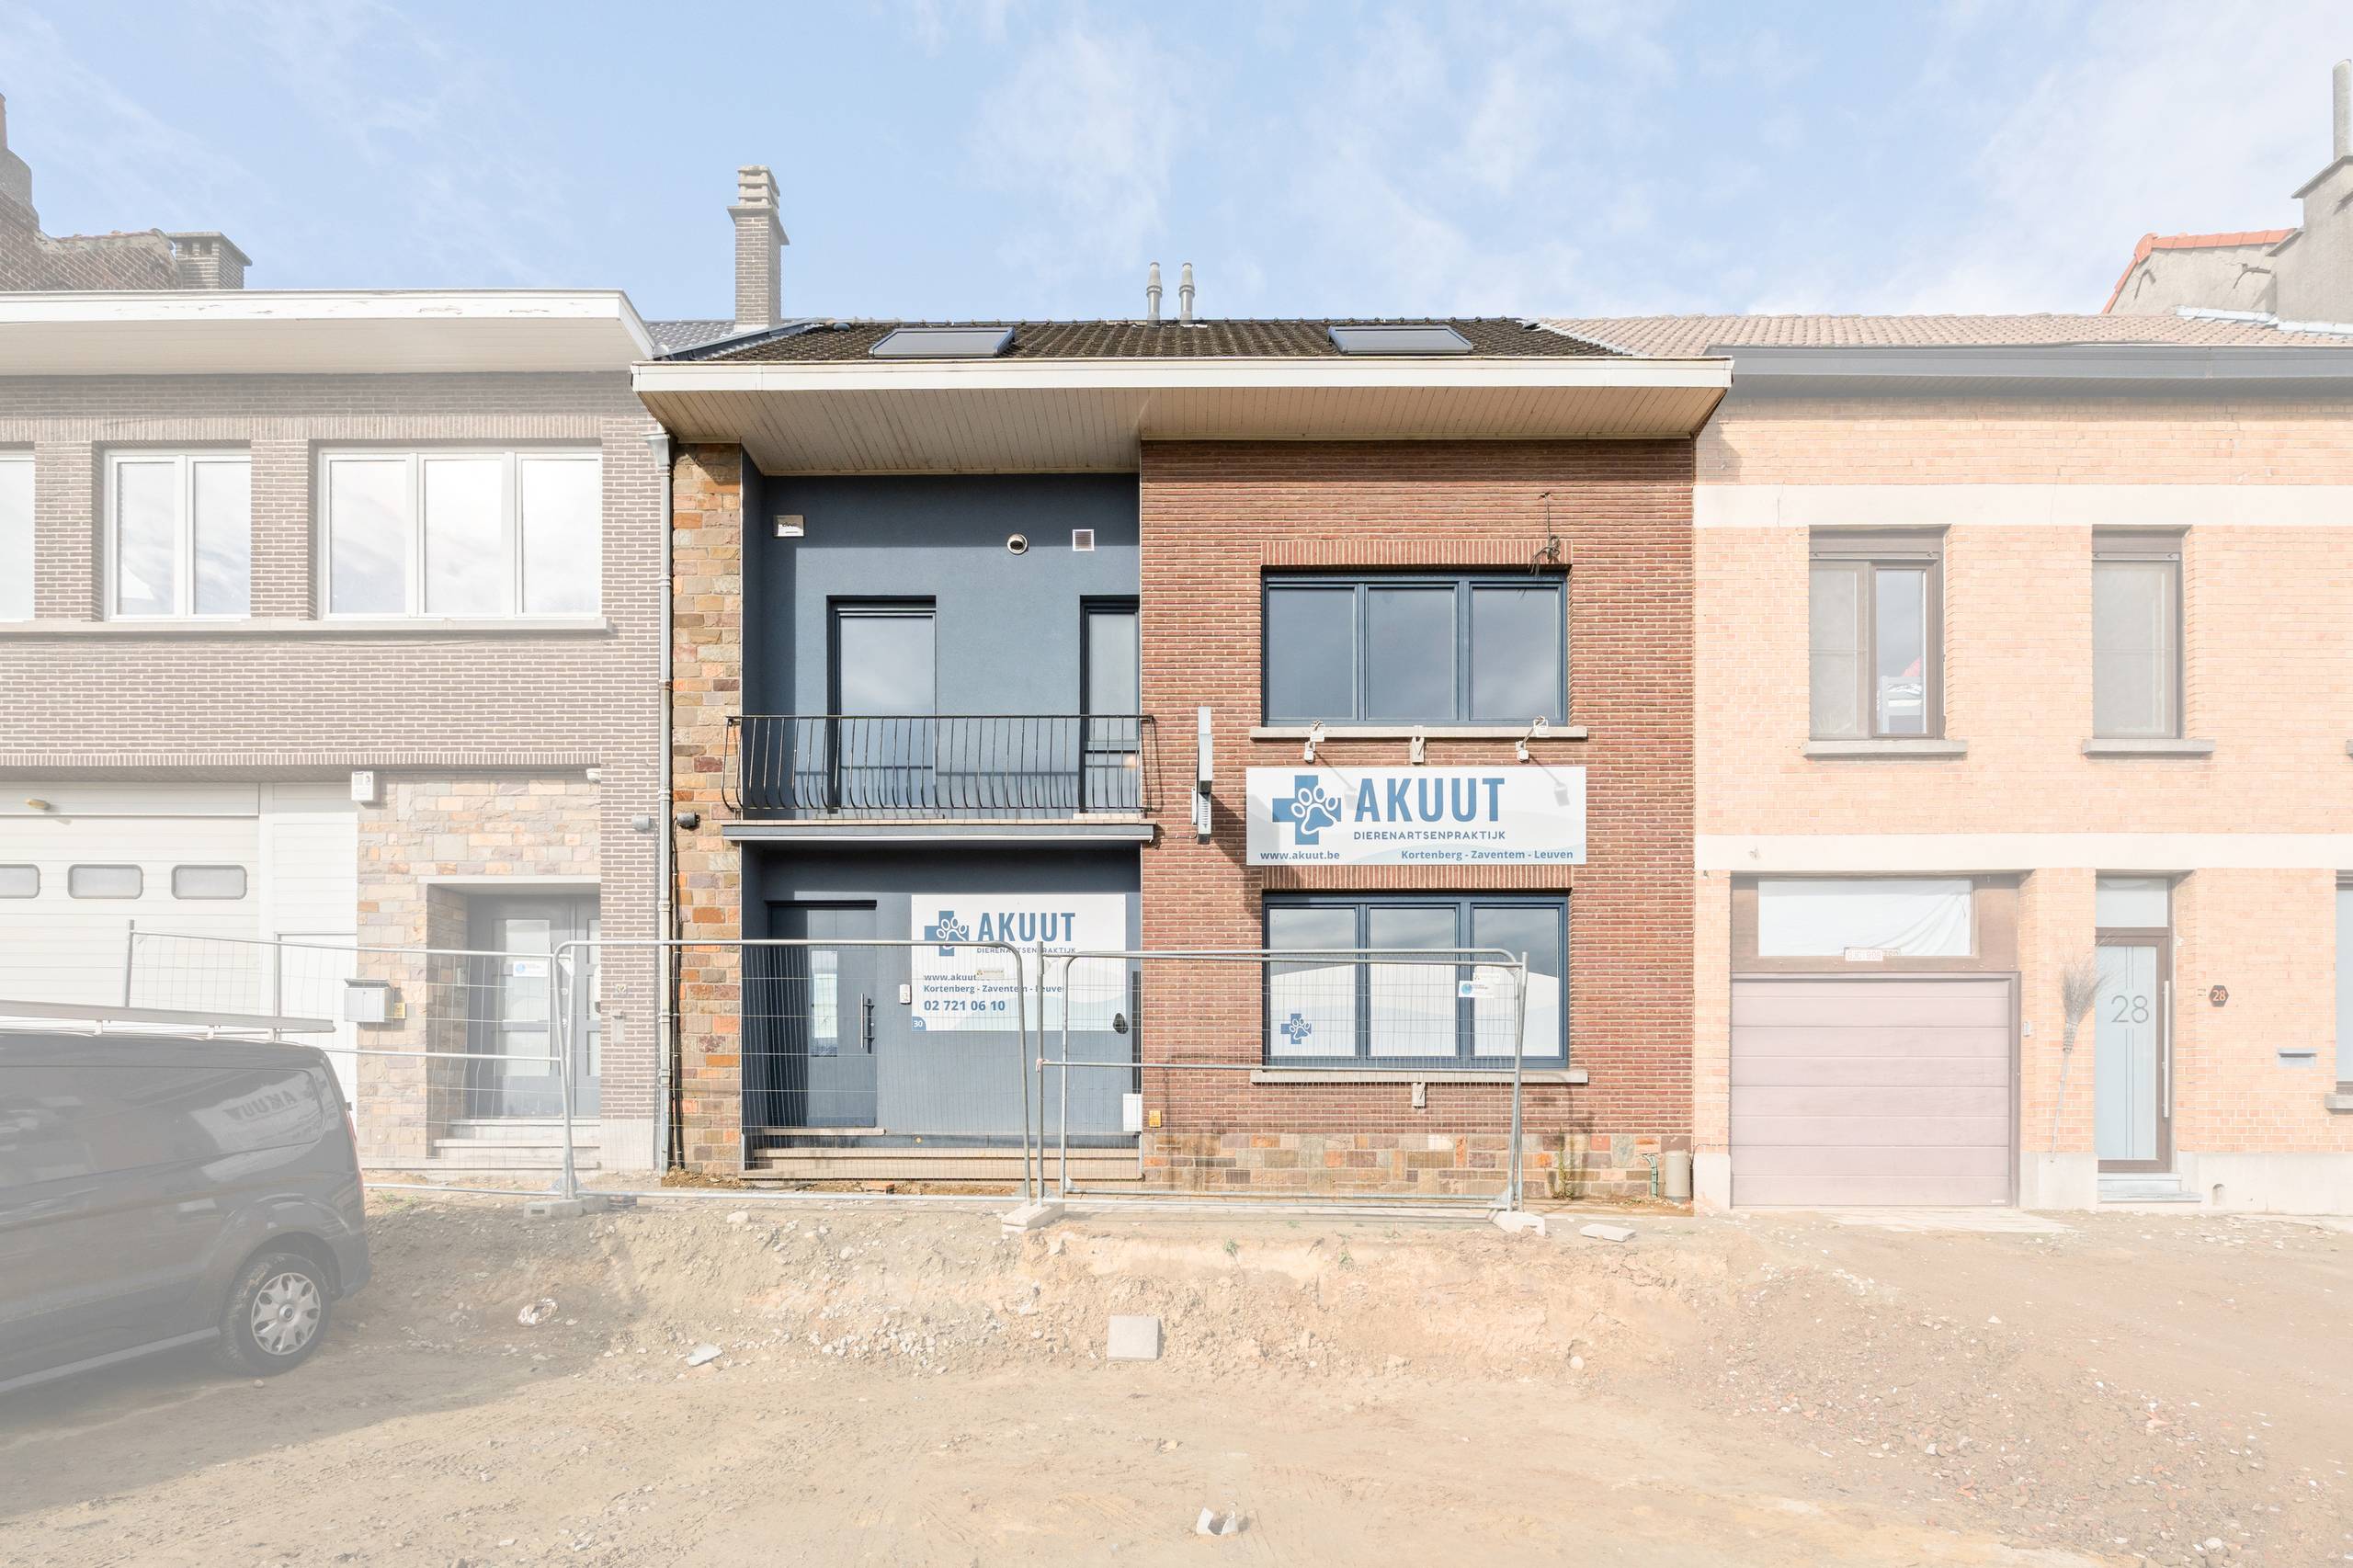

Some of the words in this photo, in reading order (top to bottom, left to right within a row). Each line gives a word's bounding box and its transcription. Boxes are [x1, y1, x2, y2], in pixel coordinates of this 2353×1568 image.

[1354, 778, 1506, 823] AKUUT
[1353, 831, 1506, 840] DIERENARTSENPRAKTIJK
[1259, 850, 1340, 860] www.akuut.be
[1401, 849, 1463, 861] Kortenberg
[1471, 850, 1526, 859] Zaventem
[1534, 850, 1574, 859] Leuven
[977, 912, 1075, 942] AKUUT
[924, 984, 975, 994] Kortenberg
[2212, 989, 2226, 1001] 28
[924, 1000, 939, 1011] 02
[943, 1000, 966, 1011] 721
[971, 1000, 986, 1011] 06
[990, 1000, 1006, 1011] 10
[2110, 994, 2150, 1024] 28
